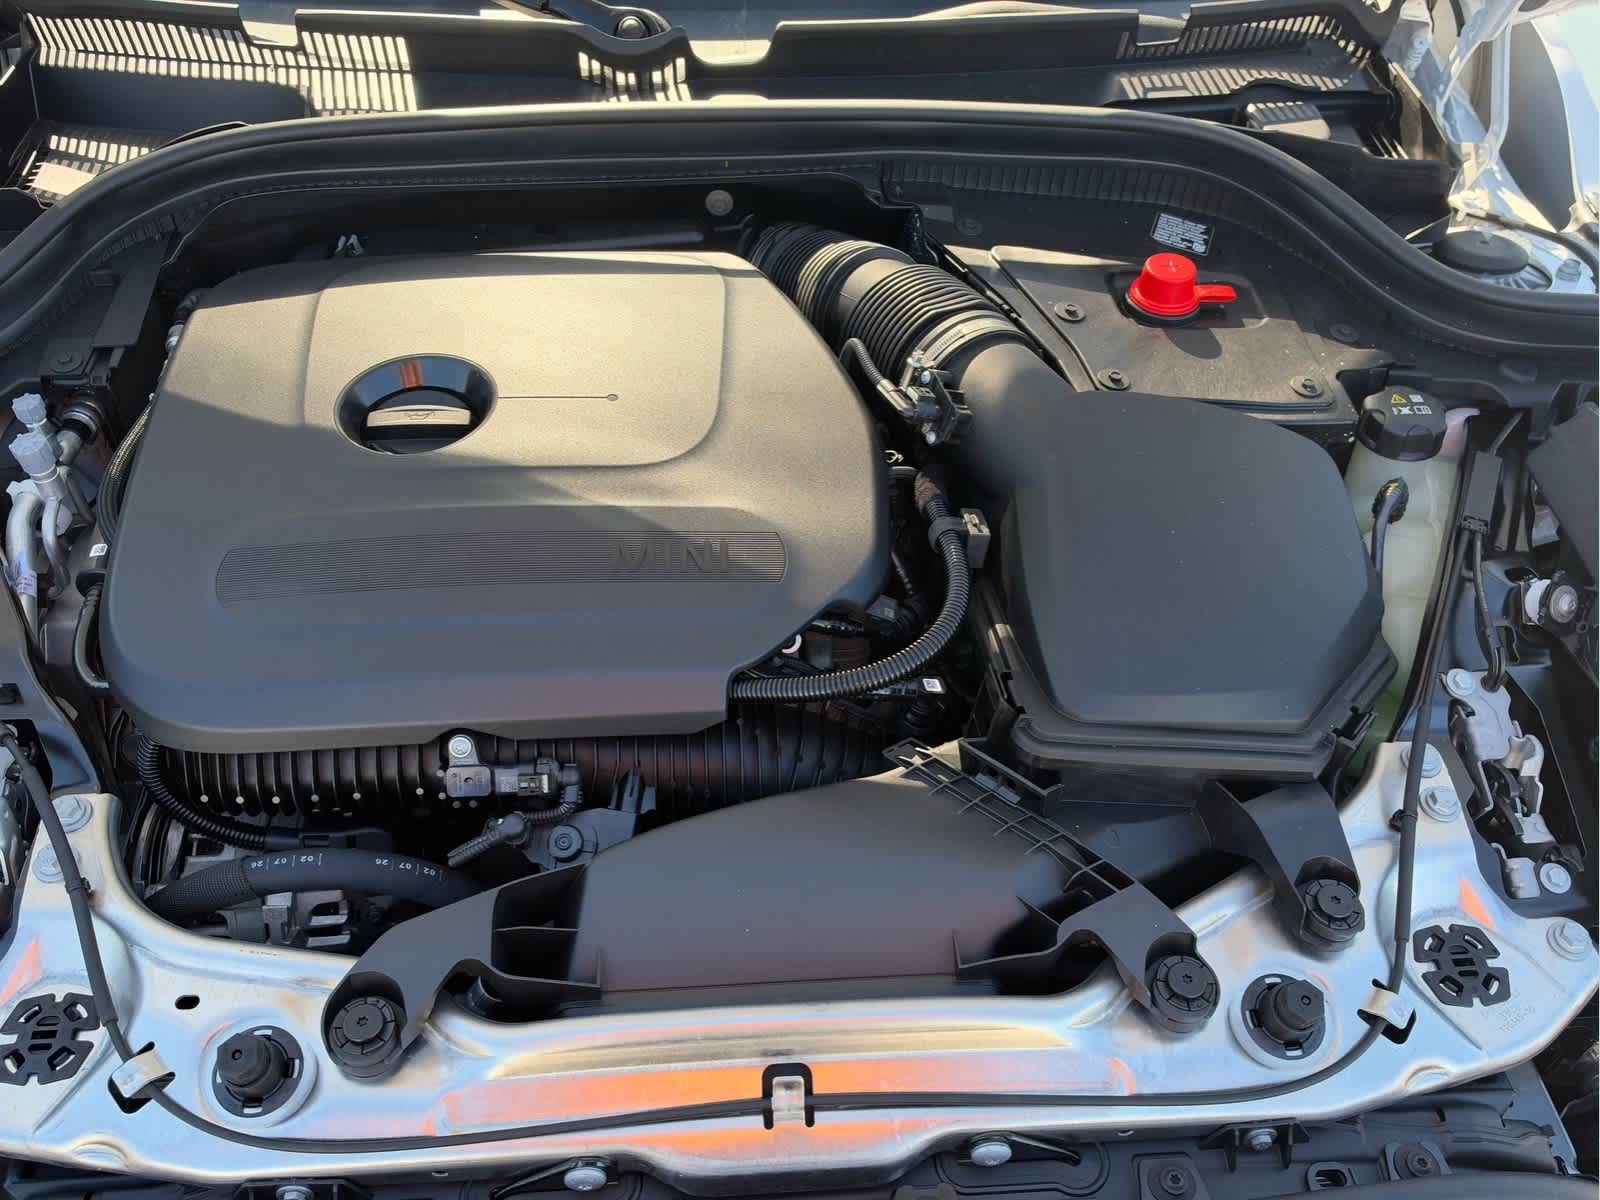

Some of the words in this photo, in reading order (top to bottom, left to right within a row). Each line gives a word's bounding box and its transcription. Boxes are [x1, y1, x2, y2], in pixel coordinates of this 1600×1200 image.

[607, 539, 729, 573] MINI
[274, 857, 288, 865] 07
[299, 855, 314, 863] 02
[375, 857, 389, 866] 26
[399, 862, 412, 871] 07
[423, 866, 436, 876] 02
